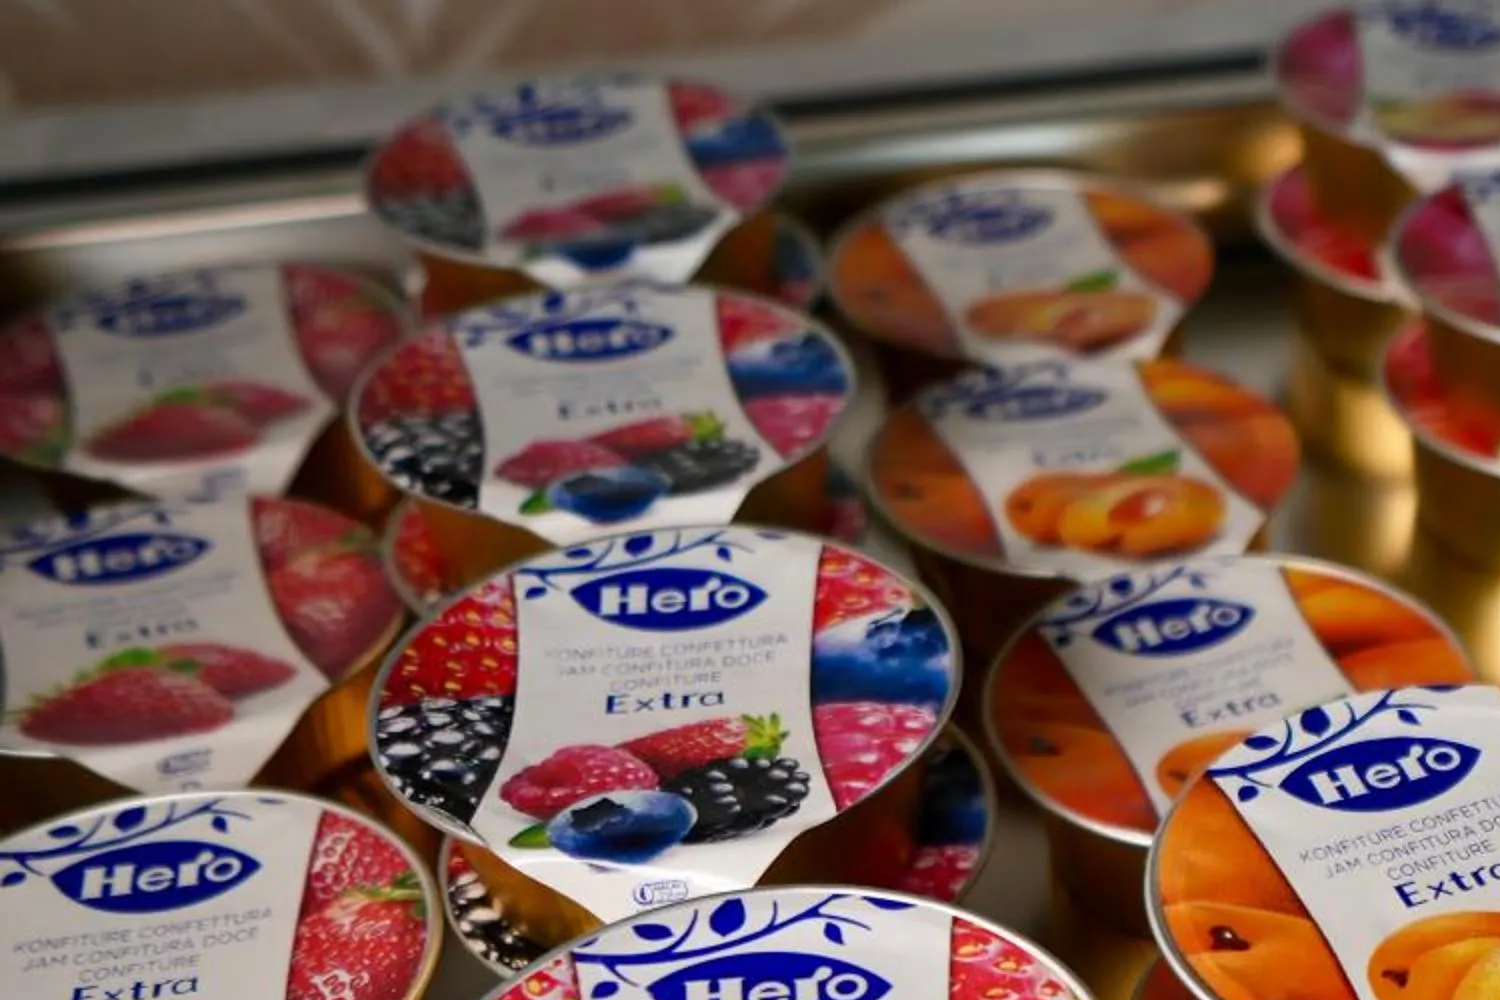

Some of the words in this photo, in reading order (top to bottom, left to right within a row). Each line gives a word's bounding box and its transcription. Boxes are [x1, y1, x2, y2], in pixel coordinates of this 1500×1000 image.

[600, 578, 750, 615] Hero
[1113, 604, 1241, 651] Hero
[605, 691, 725, 714] Extra
[1308, 743, 1461, 805] Hero
[1299, 824, 1409, 863] KONFITURE
[1367, 825, 1475, 866] CONFITURA
[1386, 839, 1498, 881] CONFITURE
[81, 850, 242, 900] Hero
